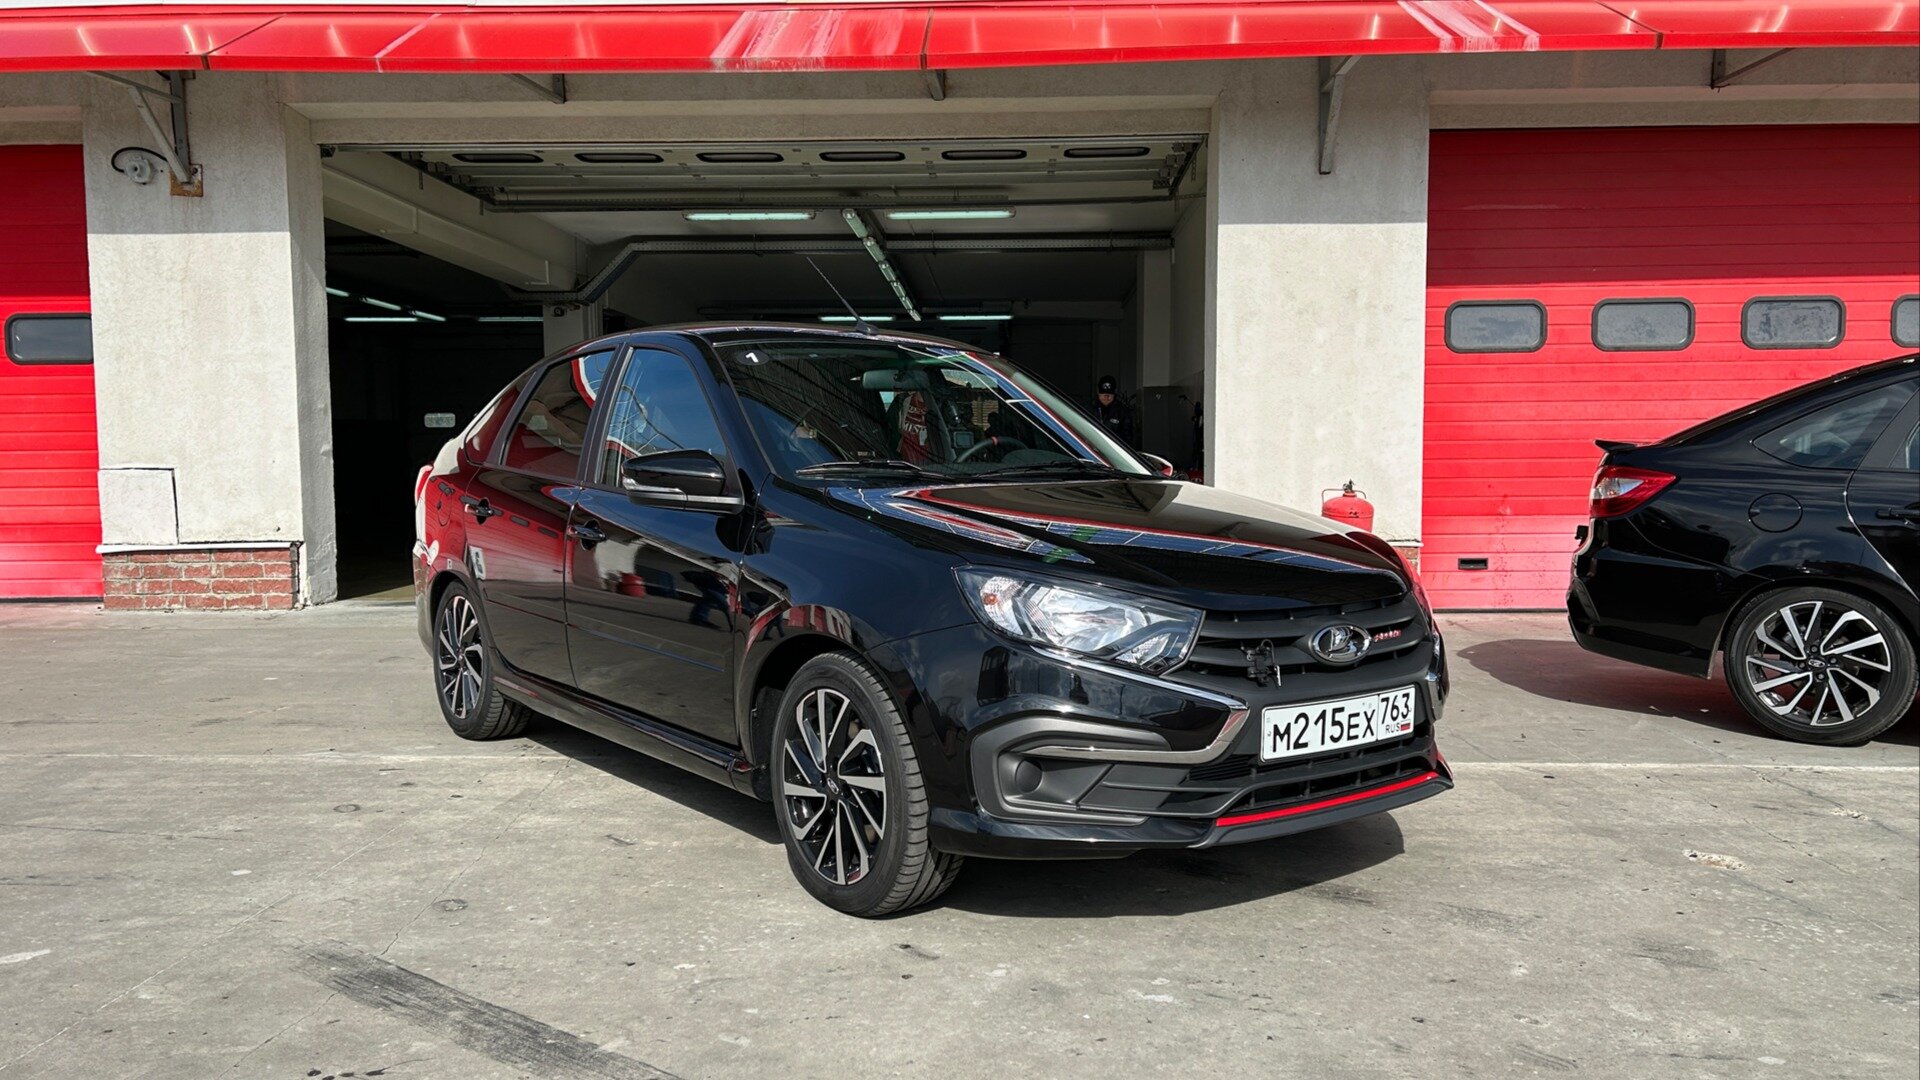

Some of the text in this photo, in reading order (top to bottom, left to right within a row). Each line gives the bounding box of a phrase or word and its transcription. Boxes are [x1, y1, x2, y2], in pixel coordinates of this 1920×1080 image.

[745, 352, 759, 363] 1
[1272, 693, 1411, 753] M215EX 763
[1385, 722, 1400, 734] RUS
